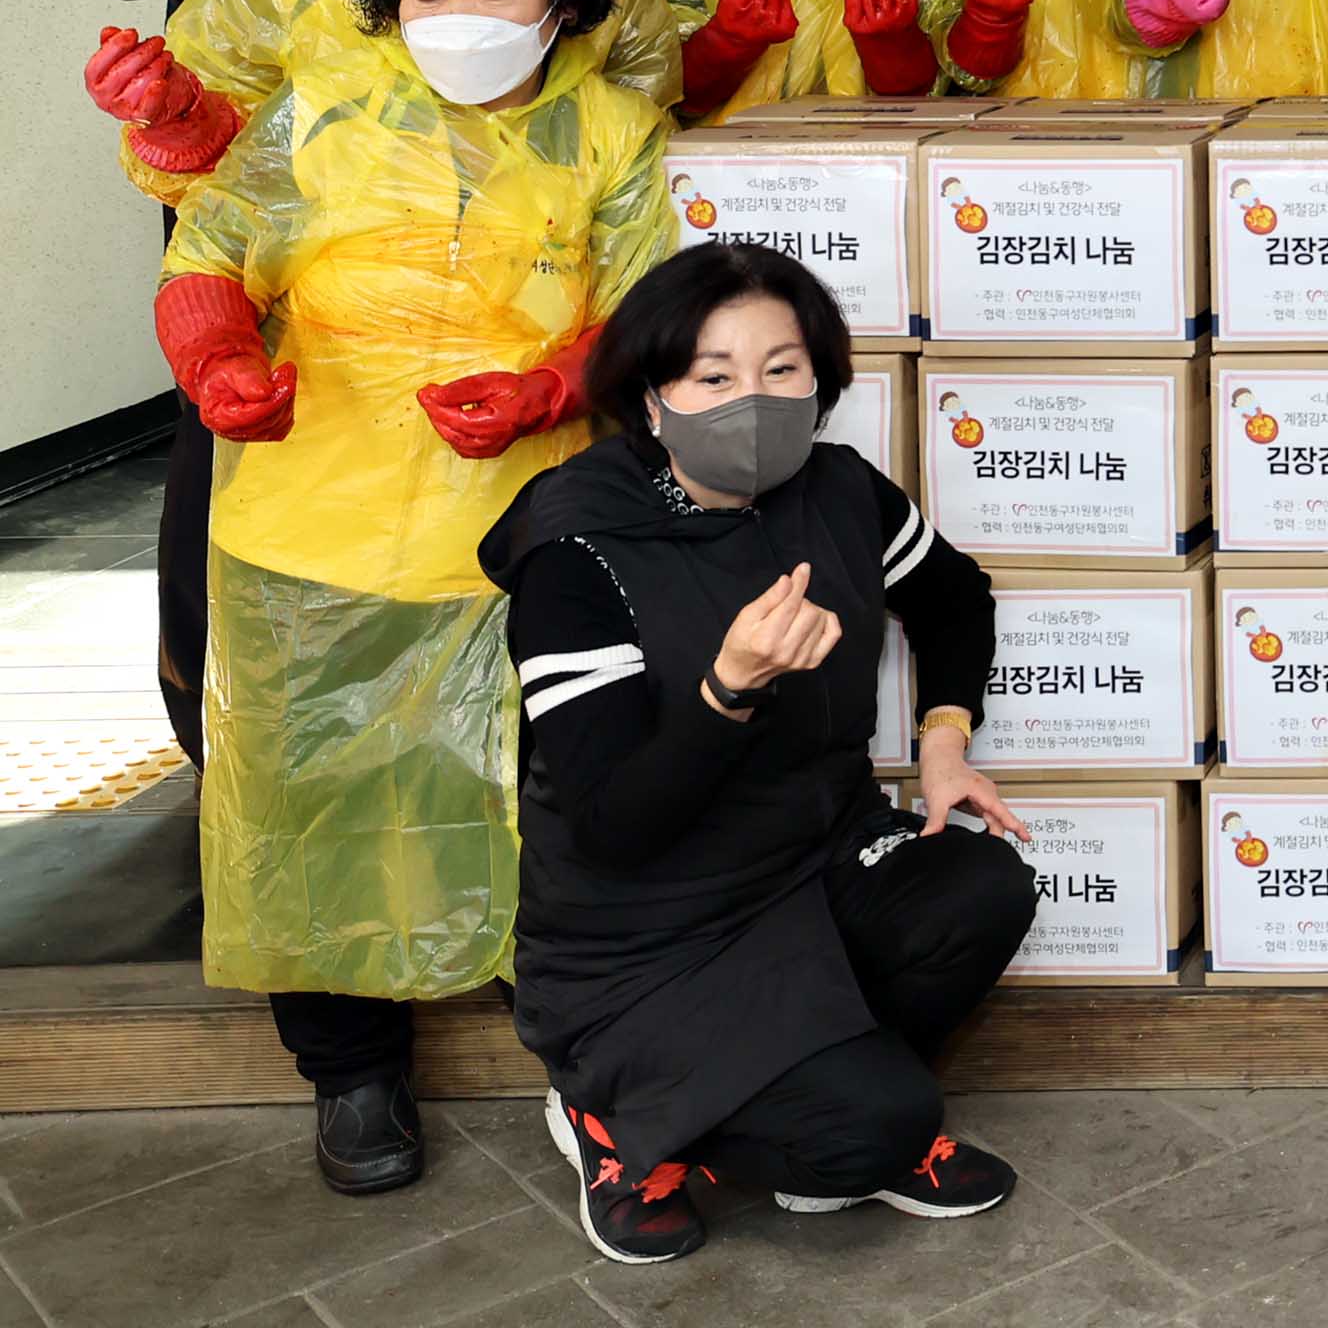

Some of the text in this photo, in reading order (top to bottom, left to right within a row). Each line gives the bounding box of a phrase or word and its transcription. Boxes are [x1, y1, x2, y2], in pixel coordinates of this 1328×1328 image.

[811, 231, 860, 261] 나눔
[976, 235, 1135, 265] 김장김치 나눔
[973, 450, 1127, 481] 김장김치 나눔
[986, 665, 1144, 695] 김장김치 나눔
[1068, 873, 1118, 903] 나눔
